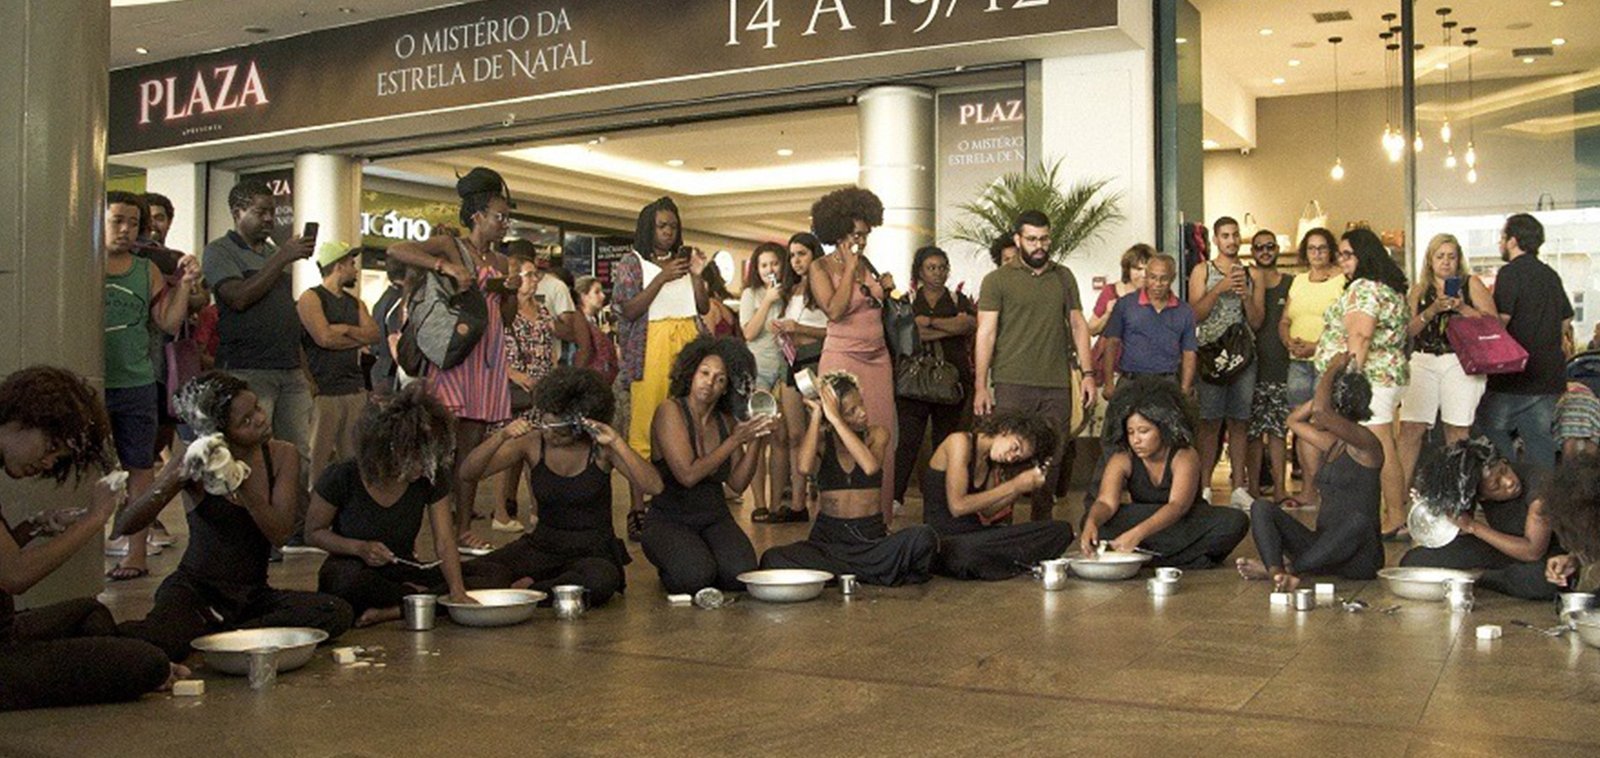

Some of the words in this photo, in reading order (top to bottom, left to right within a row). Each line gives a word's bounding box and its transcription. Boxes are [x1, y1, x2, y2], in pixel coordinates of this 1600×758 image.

[395, 34, 415, 59] O
[421, 15, 530, 56] MISTÉRIO
[537, 7, 571, 37] DA
[725, 0, 781, 48] 14
[801, 0, 856, 36] A
[139, 61, 270, 125] PLAZA
[377, 61, 466, 96] ESTRELA
[473, 54, 503, 82] DE
[507, 40, 594, 79] NATAL
[960, 100, 1025, 125] PLAZ
[957, 140, 970, 152] O
